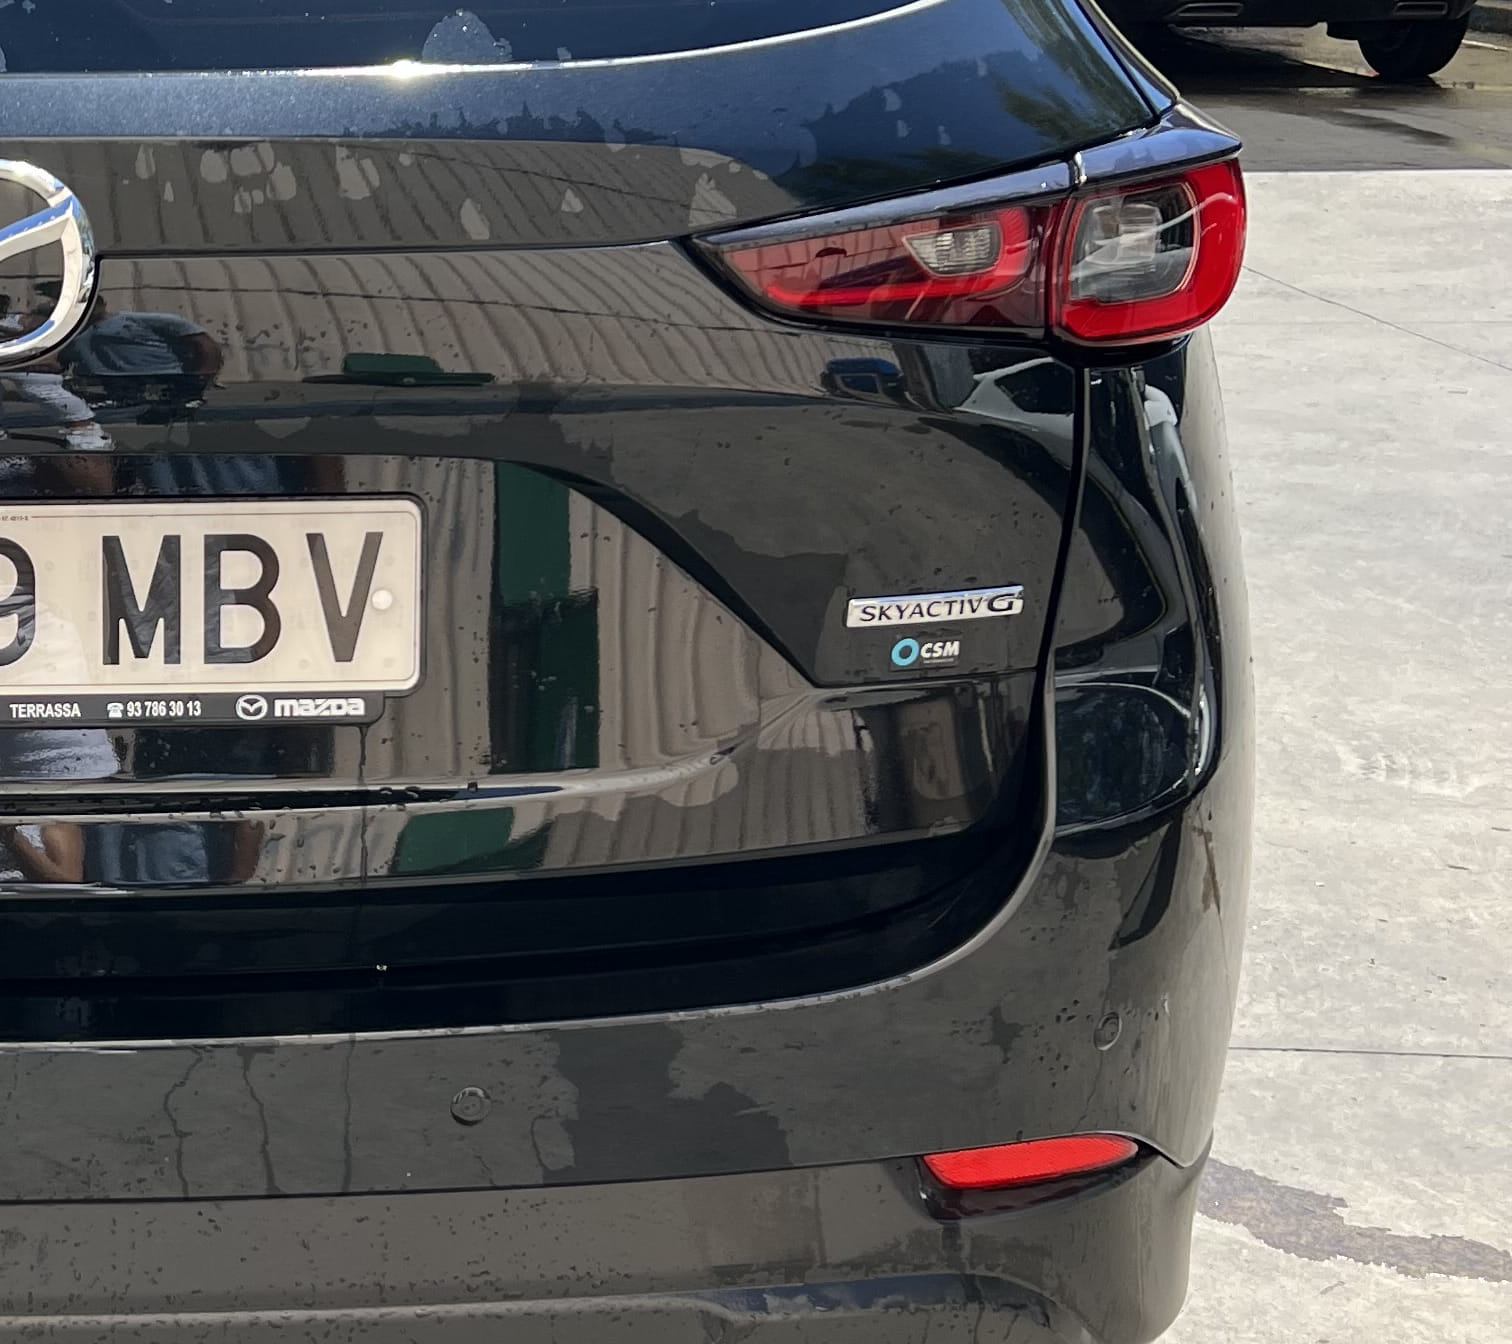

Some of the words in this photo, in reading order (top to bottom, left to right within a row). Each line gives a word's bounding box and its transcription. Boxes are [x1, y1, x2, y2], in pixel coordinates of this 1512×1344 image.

[102, 531, 384, 665] MBV
[920, 640, 960, 659] CSM
[9, 703, 82, 718] TERRASSA
[127, 701, 142, 717] 93
[144, 701, 167, 716] 786
[169, 701, 184, 716] 30
[187, 701, 201, 716] 13
